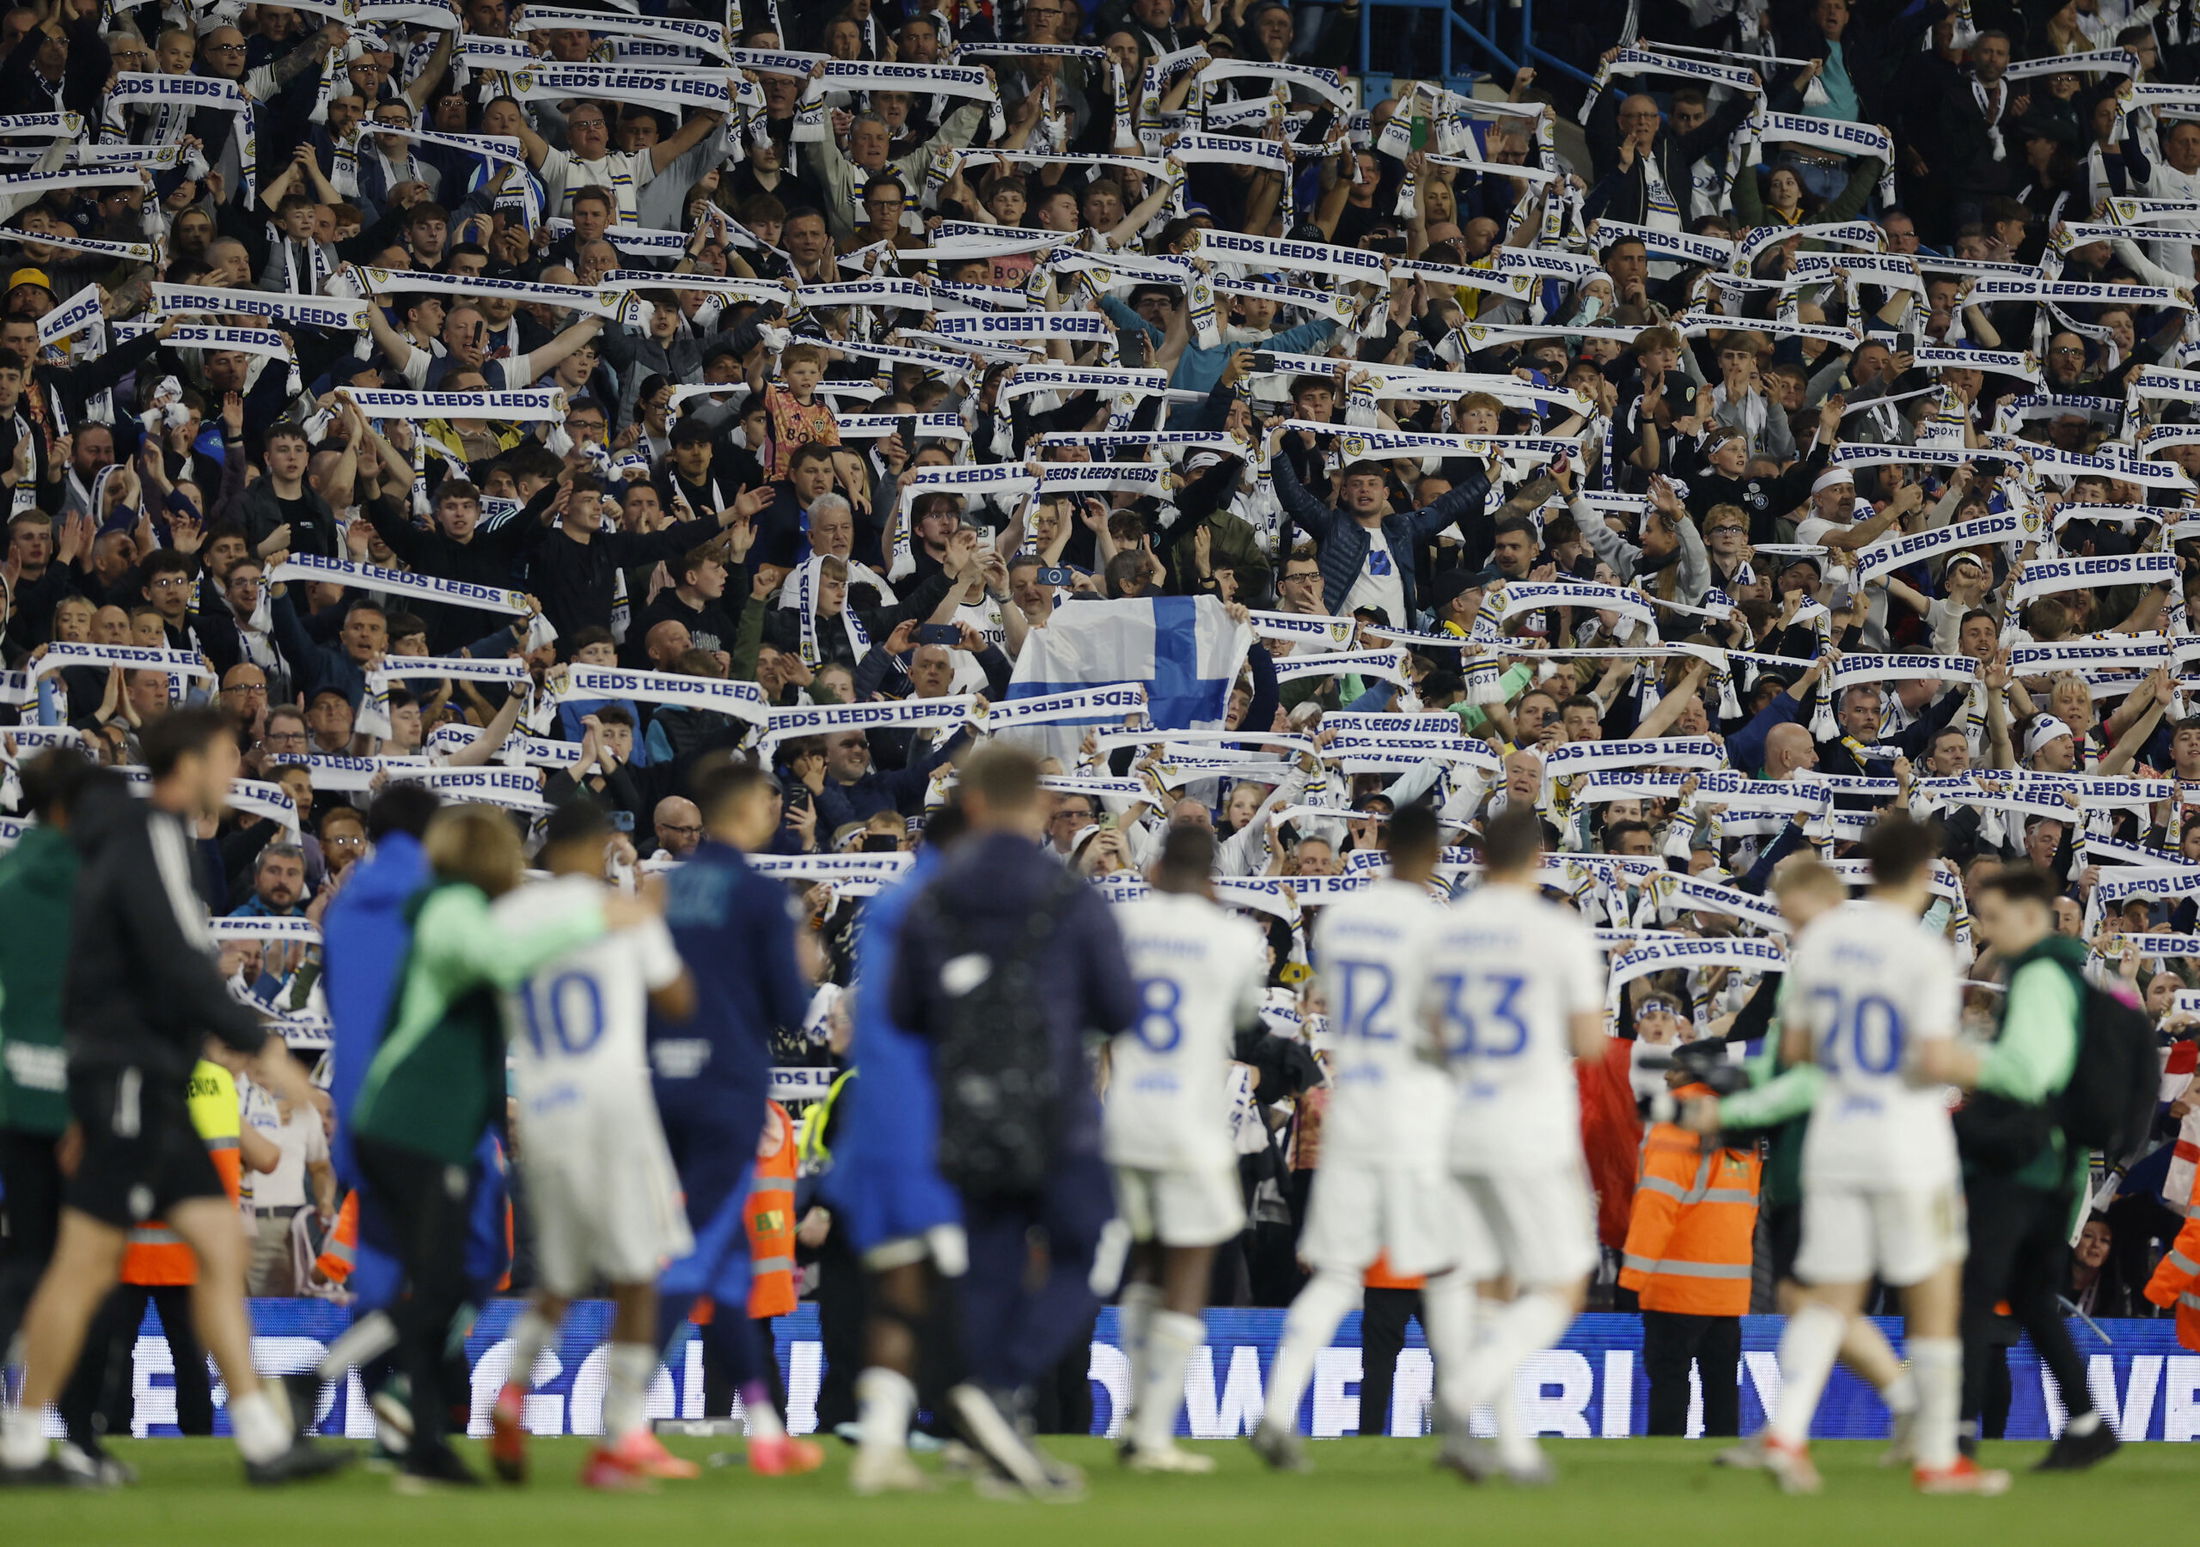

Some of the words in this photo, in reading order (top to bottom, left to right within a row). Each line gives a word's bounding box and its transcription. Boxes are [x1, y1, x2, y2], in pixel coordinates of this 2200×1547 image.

[658, 20, 719, 42] LEEDS
[618, 41, 680, 57] LEEDS
[751, 53, 814, 72] LEEDS
[873, 64, 928, 78] LEEDS
[930, 68, 984, 85] LEEDS
[160, 79, 221, 97] LEEDS
[539, 75, 600, 88] LEEDS
[605, 76, 667, 92] LEEDS
[671, 82, 730, 100] LEEDS
[15, 113, 60, 128] LEEDS
[1775, 114, 1830, 137] LEEDS
[1833, 126, 1889, 150] LEEDS
[1197, 139, 1252, 154] LEEDS
[1206, 234, 1264, 254] LEEDS
[1270, 241, 1328, 262] LEEDS
[1332, 252, 1390, 270] LEEDS
[1529, 254, 1572, 274] LEEDS
[1833, 256, 1878, 270] LEEDS
[823, 279, 884, 295] LEEDS
[1975, 280, 2037, 294] LEEDS
[2040, 282, 2103, 297] LEEDS
[2106, 284, 2169, 299] LEEDS
[44, 297, 100, 338] LEEDS
[161, 295, 219, 310] LEEDS
[225, 298, 285, 320] LEEDS
[289, 303, 348, 327] LEEDS
[983, 315, 1044, 333] LEEDS
[213, 330, 283, 347] LEEDS
[1916, 349, 1966, 361] LEEDS
[1969, 351, 2021, 366] LEEDS
[1069, 373, 1131, 386] LEEDS
[358, 391, 422, 406] LEEDS
[425, 392, 489, 408] LEEDS
[492, 393, 553, 409] LEEDS
[2051, 393, 2103, 411] LEEDS
[1157, 431, 1225, 443] LEEDS
[1934, 426, 1960, 438] BOXT
[1831, 445, 1893, 462] LEEDS
[1897, 449, 1960, 462] LEEDS
[2060, 450, 2116, 472] LEEDS
[2119, 460, 2175, 479] LEEDS
[943, 468, 1006, 484] LEEDS
[1081, 466, 1122, 483] LEEDS
[1121, 467, 1158, 483] LEEDS
[1892, 530, 1952, 560] LEEDS
[1955, 516, 2018, 540] LEEDS
[2074, 557, 2132, 575] LEEDS
[287, 551, 356, 574] LEEDS
[361, 563, 429, 588] LEEDS
[434, 577, 501, 603] LEEDS
[800, 577, 810, 636] LEEDS
[96, 645, 163, 663] LEEDS
[2058, 647, 2119, 660] LEEDS
[1833, 655, 1884, 675] LEEDS
[1887, 654, 1940, 670] LEEDS
[575, 674, 638, 691] LEEDS
[643, 677, 705, 694] LEEDS
[711, 682, 760, 702] LEED
[1468, 673, 1498, 687] BOXT
[826, 707, 896, 726] LEEDS
[900, 702, 965, 720] LEEDS
[1365, 718, 1411, 733] LEEDS
[1413, 718, 1460, 735] LEEDS
[1441, 738, 1499, 759] LEEDS
[1589, 742, 1658, 757] LEEDS
[1662, 742, 1726, 761] LEEDS
[325, 755, 375, 773] LEEDS
[430, 772, 487, 788] LEEDS
[490, 773, 543, 795] LEEDS
[1588, 771, 1645, 787] LEEDS
[1741, 780, 1790, 797] LEEDS
[2082, 781, 2142, 798] LEEDS
[1680, 881, 1737, 907] LEEDS
[1664, 941, 1728, 958] LEEDS
[1334, 958, 1399, 1041] 12
[521, 970, 604, 1058] 10
[1136, 976, 1184, 1053] 8
[1434, 972, 1530, 1057] 33
[1810, 985, 1905, 1074] 20
